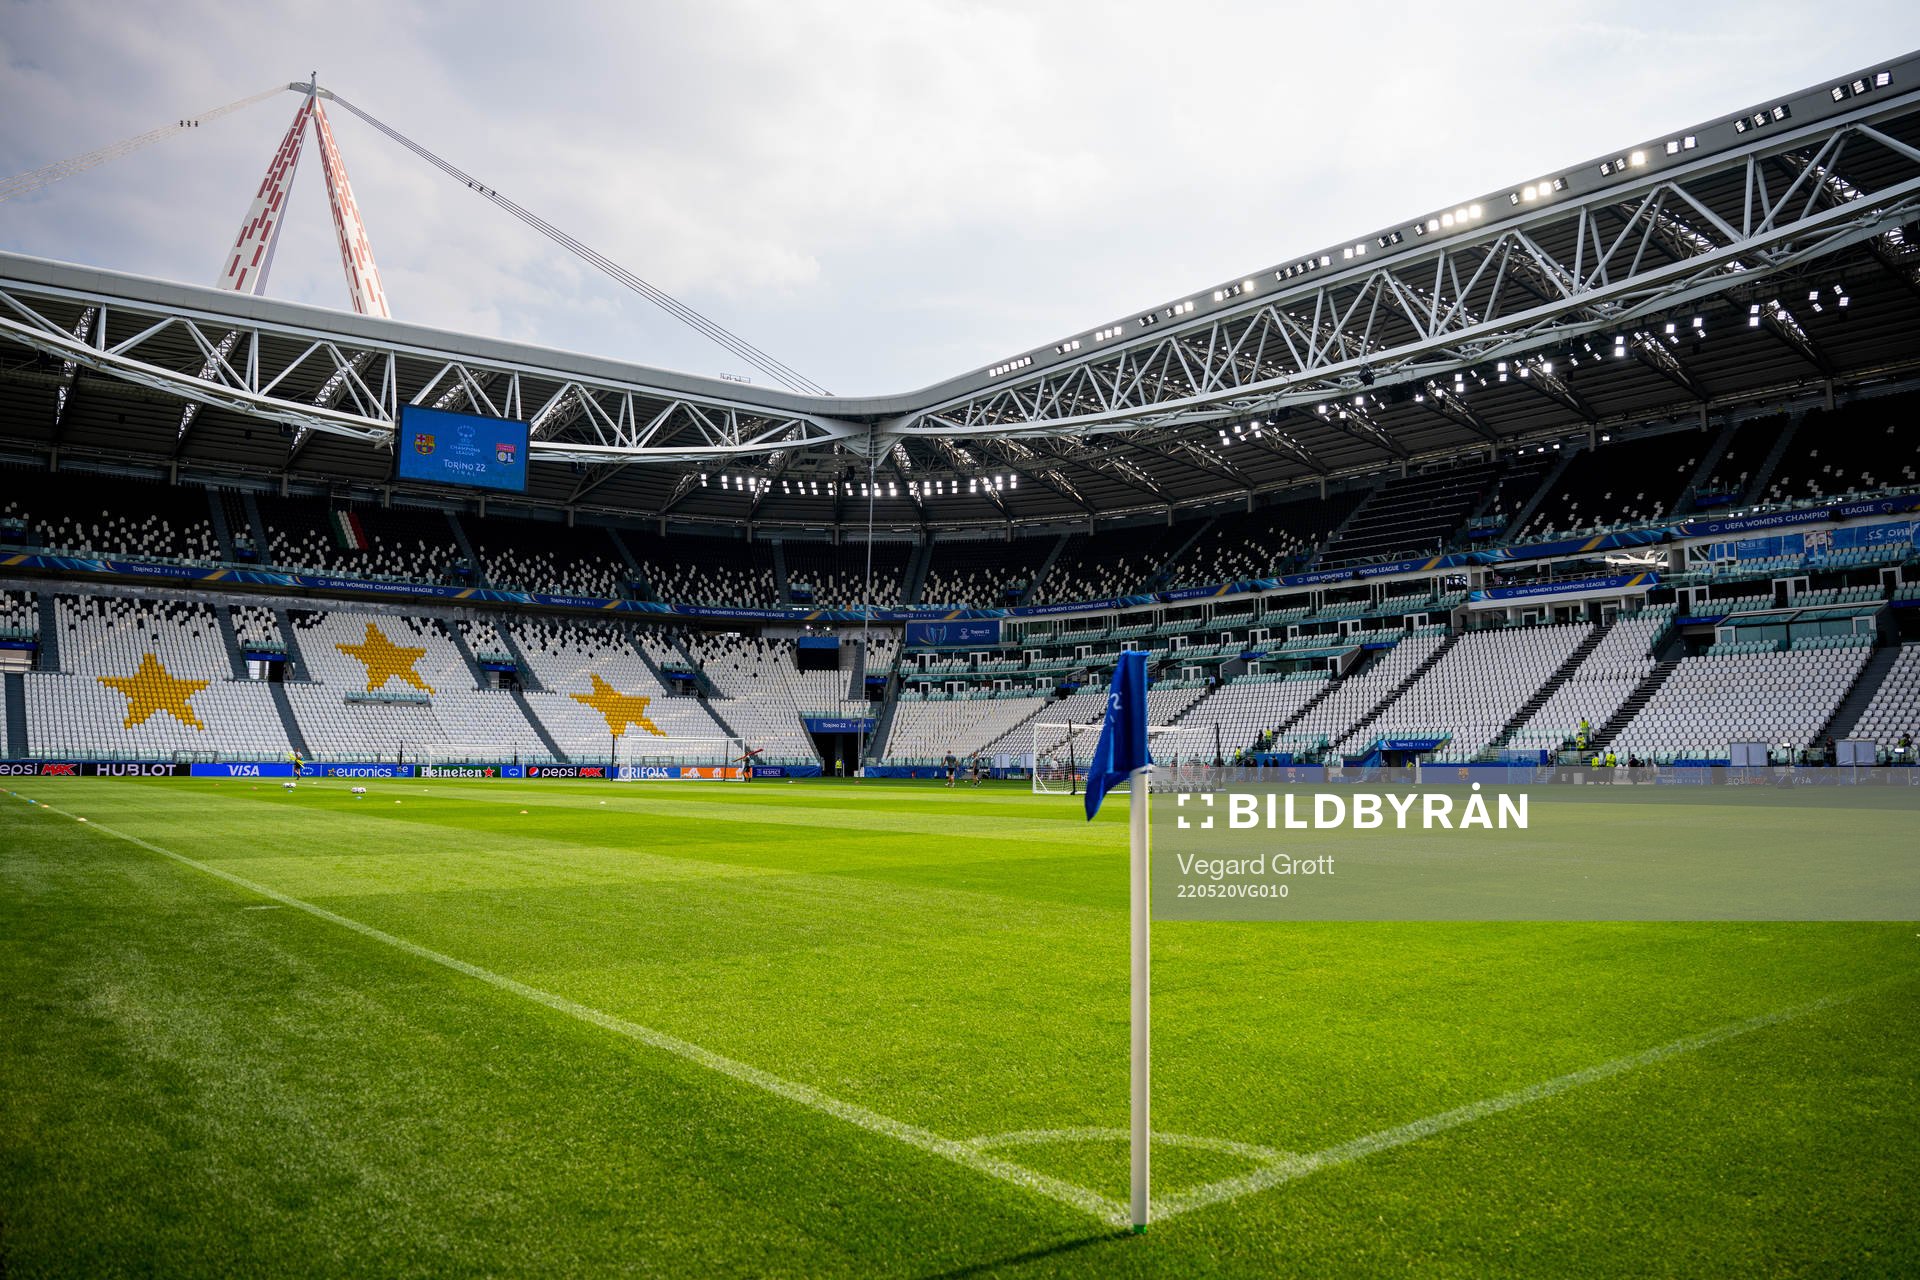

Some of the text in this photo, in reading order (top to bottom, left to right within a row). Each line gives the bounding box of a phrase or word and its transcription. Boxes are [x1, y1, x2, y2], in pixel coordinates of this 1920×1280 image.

[476, 463, 486, 472] 22
[1725, 505, 1874, 530] UEFA WOMEN'S CHAMPIO LEAGUE
[1378, 565, 1399, 573] LEAGUE
[374, 584, 410, 592] CHAMPIONS
[1553, 583, 1585, 591] CHAMPIONS
[1067, 603, 1093, 611] CHAMPIONS
[0, 763, 77, 776] epsi MAX
[97, 764, 176, 776] HUBLOT
[228, 765, 260, 776] VISA
[336, 765, 392, 778] euronics
[421, 766, 482, 778] Heineken
[542, 766, 603, 778] pepsi MAX
[620, 767, 668, 778] GRIFOLS
